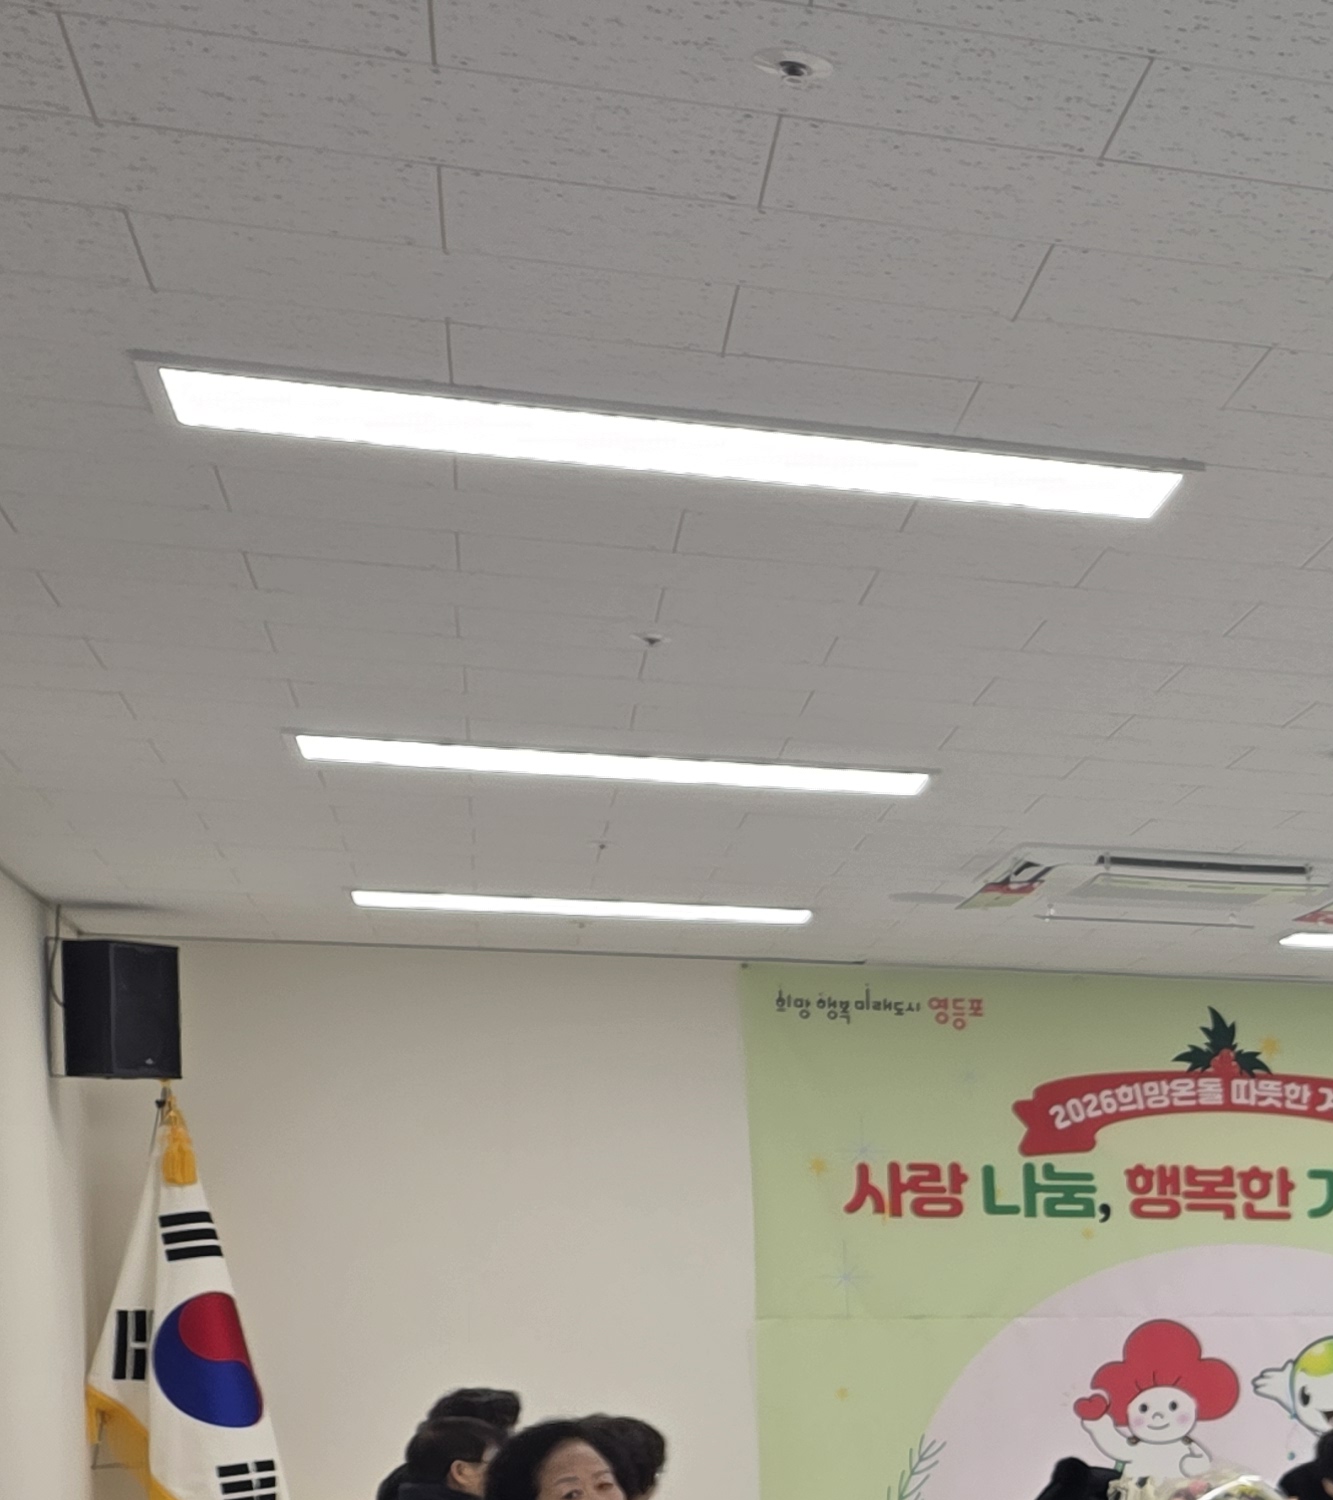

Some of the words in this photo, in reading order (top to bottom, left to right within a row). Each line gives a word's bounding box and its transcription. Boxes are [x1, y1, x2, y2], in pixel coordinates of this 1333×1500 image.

[775, 985, 811, 1020] 희망
[816, 993, 851, 1025] 행복
[854, 983, 921, 1016] 미래도시
[928, 996, 984, 1031] 영등포
[1048, 1077, 1224, 1131] 2026희망온돌
[1230, 1078, 1310, 1112] 따뜻한
[842, 1161, 969, 1219] 사랑
[982, 1161, 1112, 1224] 나눔,
[1124, 1162, 1296, 1221] 행복한
